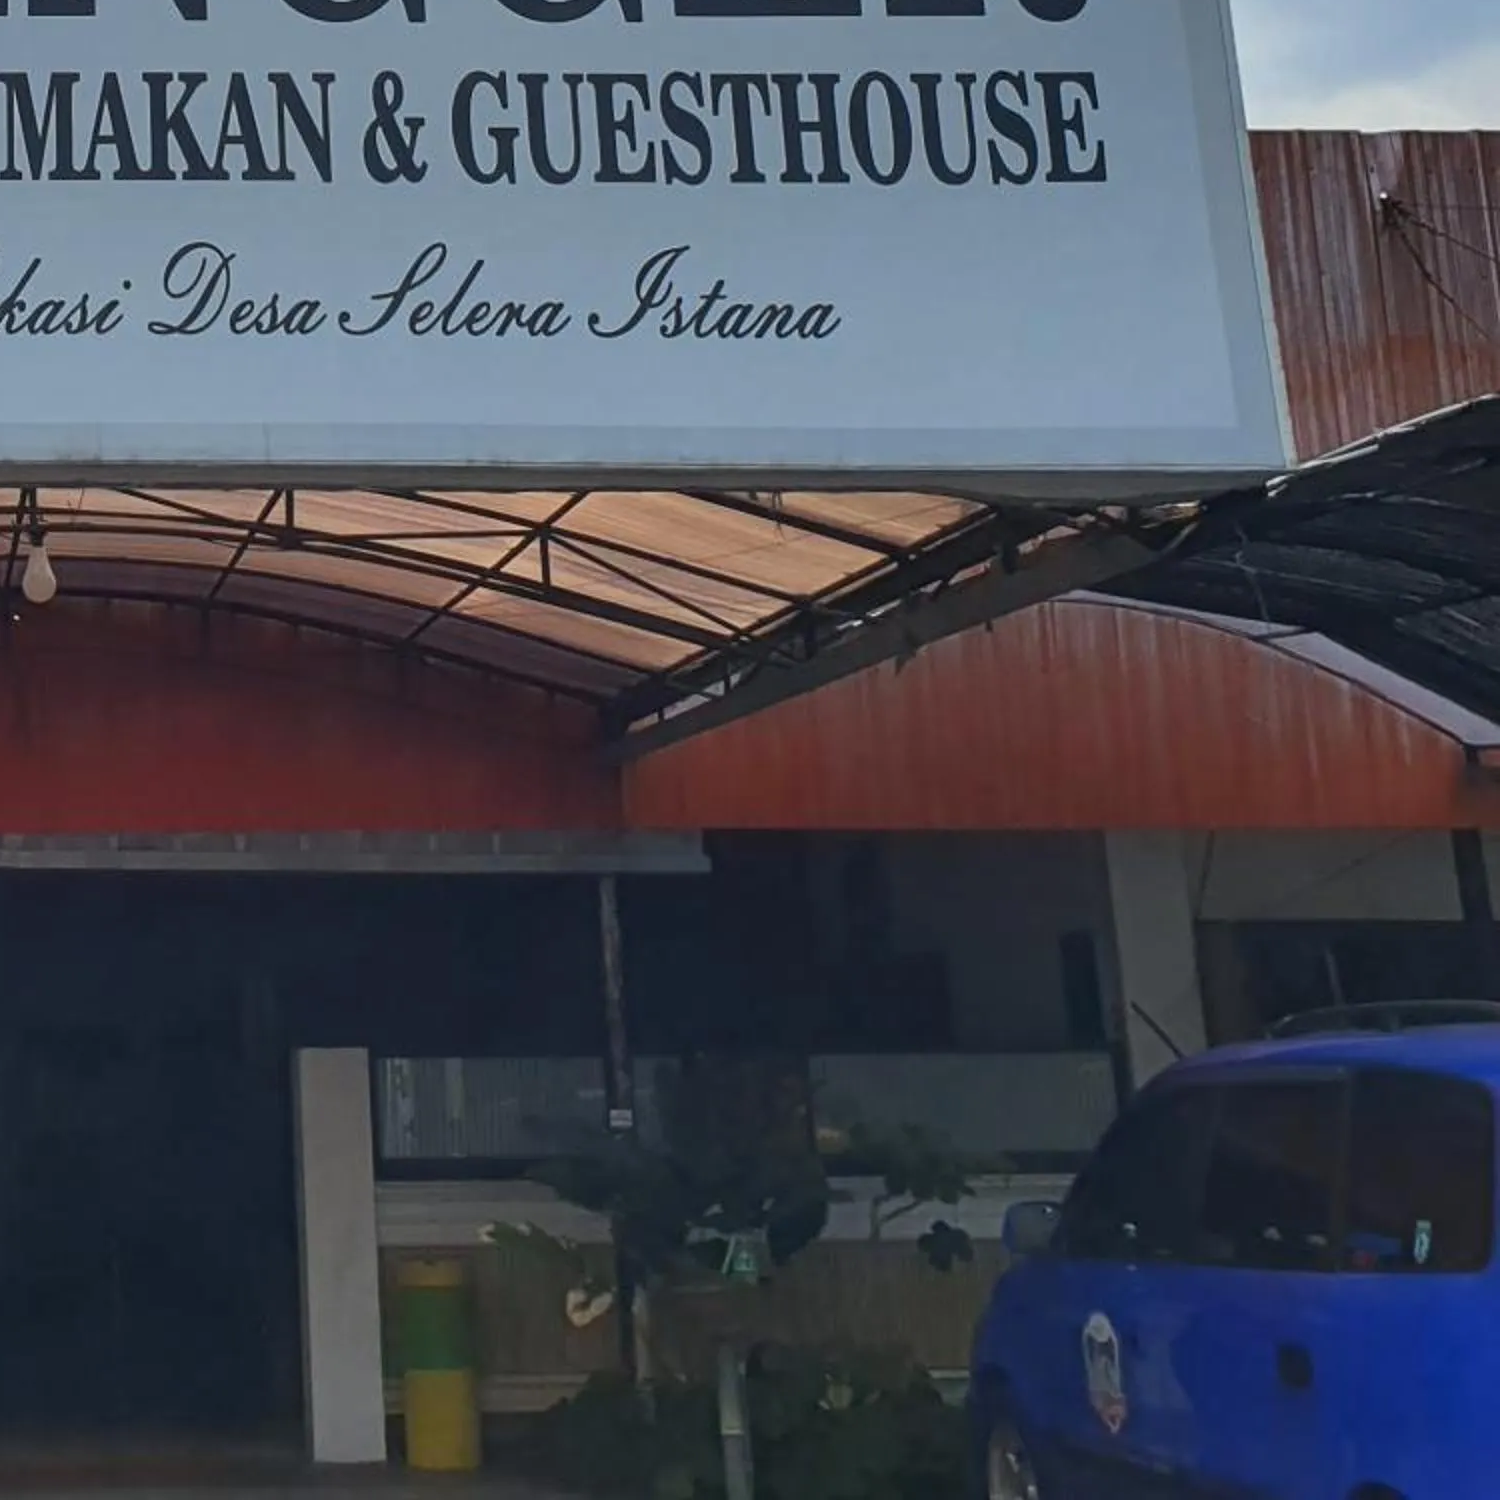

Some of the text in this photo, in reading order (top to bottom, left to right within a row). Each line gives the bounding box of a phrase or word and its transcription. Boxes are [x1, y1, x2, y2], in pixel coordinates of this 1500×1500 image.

[363, 70, 428, 185] &
[452, 70, 1107, 187] GUESTHOUSE
[148, 241, 328, 336] Desa
[337, 241, 572, 338] Selera
[587, 244, 842, 340] Istana
